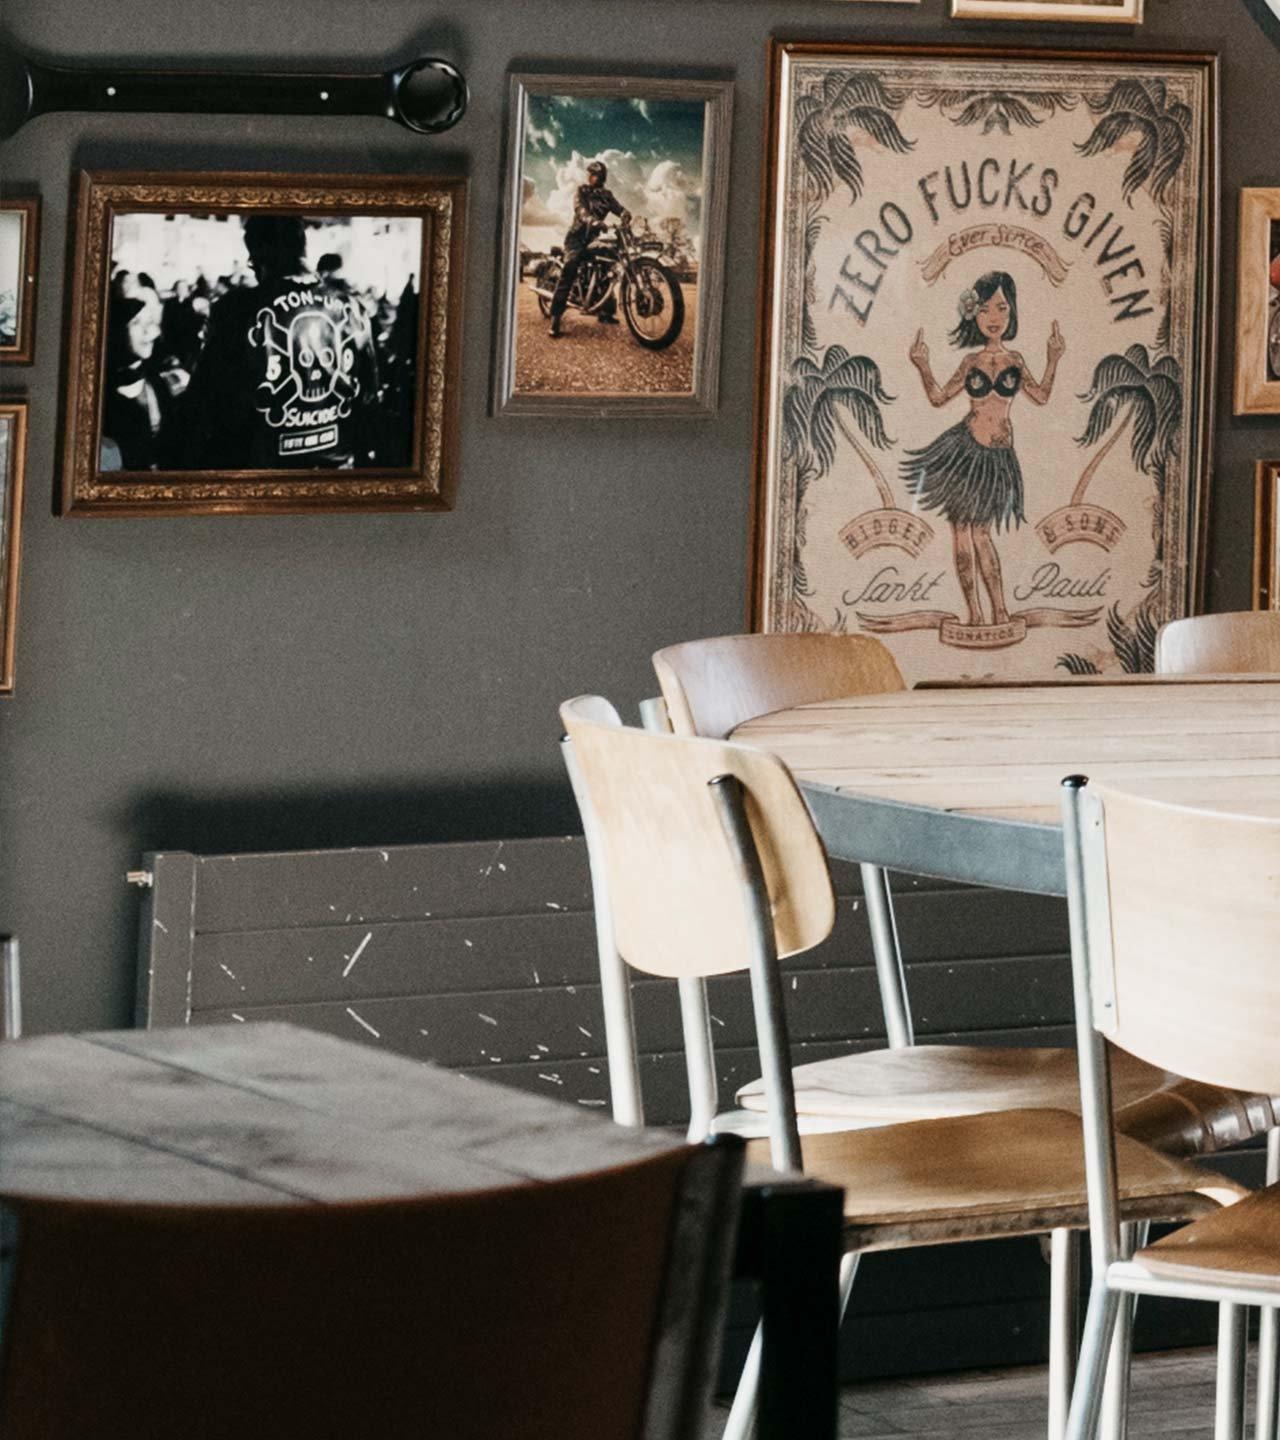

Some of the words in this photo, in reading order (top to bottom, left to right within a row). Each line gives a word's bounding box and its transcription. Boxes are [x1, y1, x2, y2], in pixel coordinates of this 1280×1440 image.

[827, 201, 914, 329] ZERO
[916, 157, 1060, 226] FUCKS
[1062, 191, 1155, 326] GIVEN
[949, 227, 989, 258] Ever
[842, 566, 946, 607] Sankt
[1013, 561, 1113, 601] Pauli
